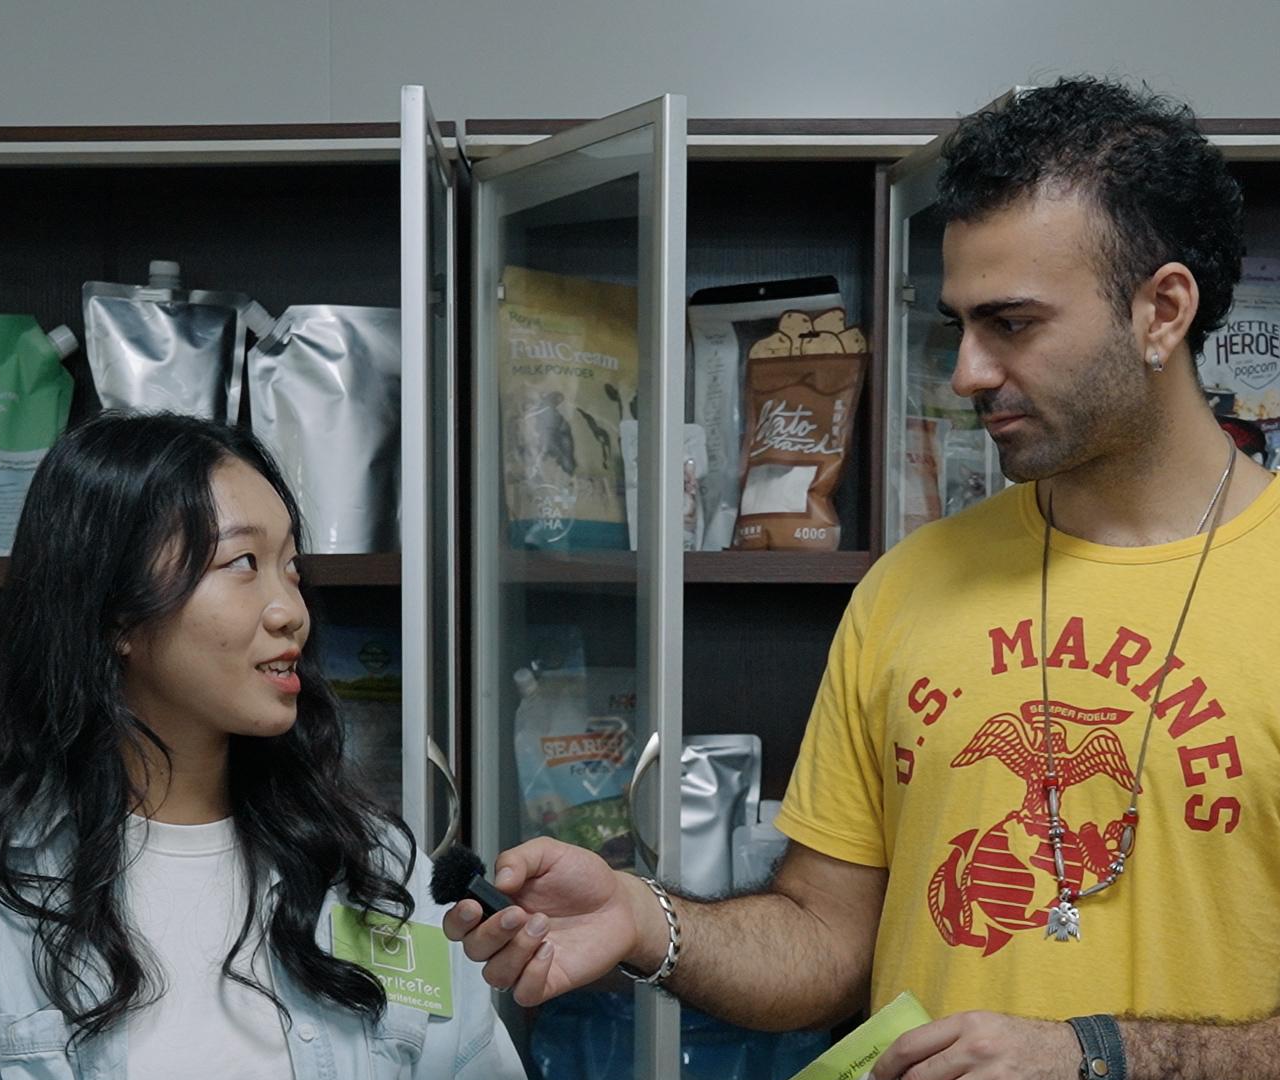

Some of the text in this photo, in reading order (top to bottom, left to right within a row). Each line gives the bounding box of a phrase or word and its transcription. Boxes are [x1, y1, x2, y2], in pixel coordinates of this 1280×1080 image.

[1227, 320, 1280, 336] KETTLE
[1234, 362, 1278, 380] popcorn
[794, 527, 827, 540] 400G
[1029, 703, 1118, 722] SEMPER FIDELIS
[894, 616, 1243, 834] U.S. MARINES
[377, 974, 441, 998] oriteTec
[388, 993, 443, 1010] oritetec.com
[852, 1046, 880, 1073] Heroes!
